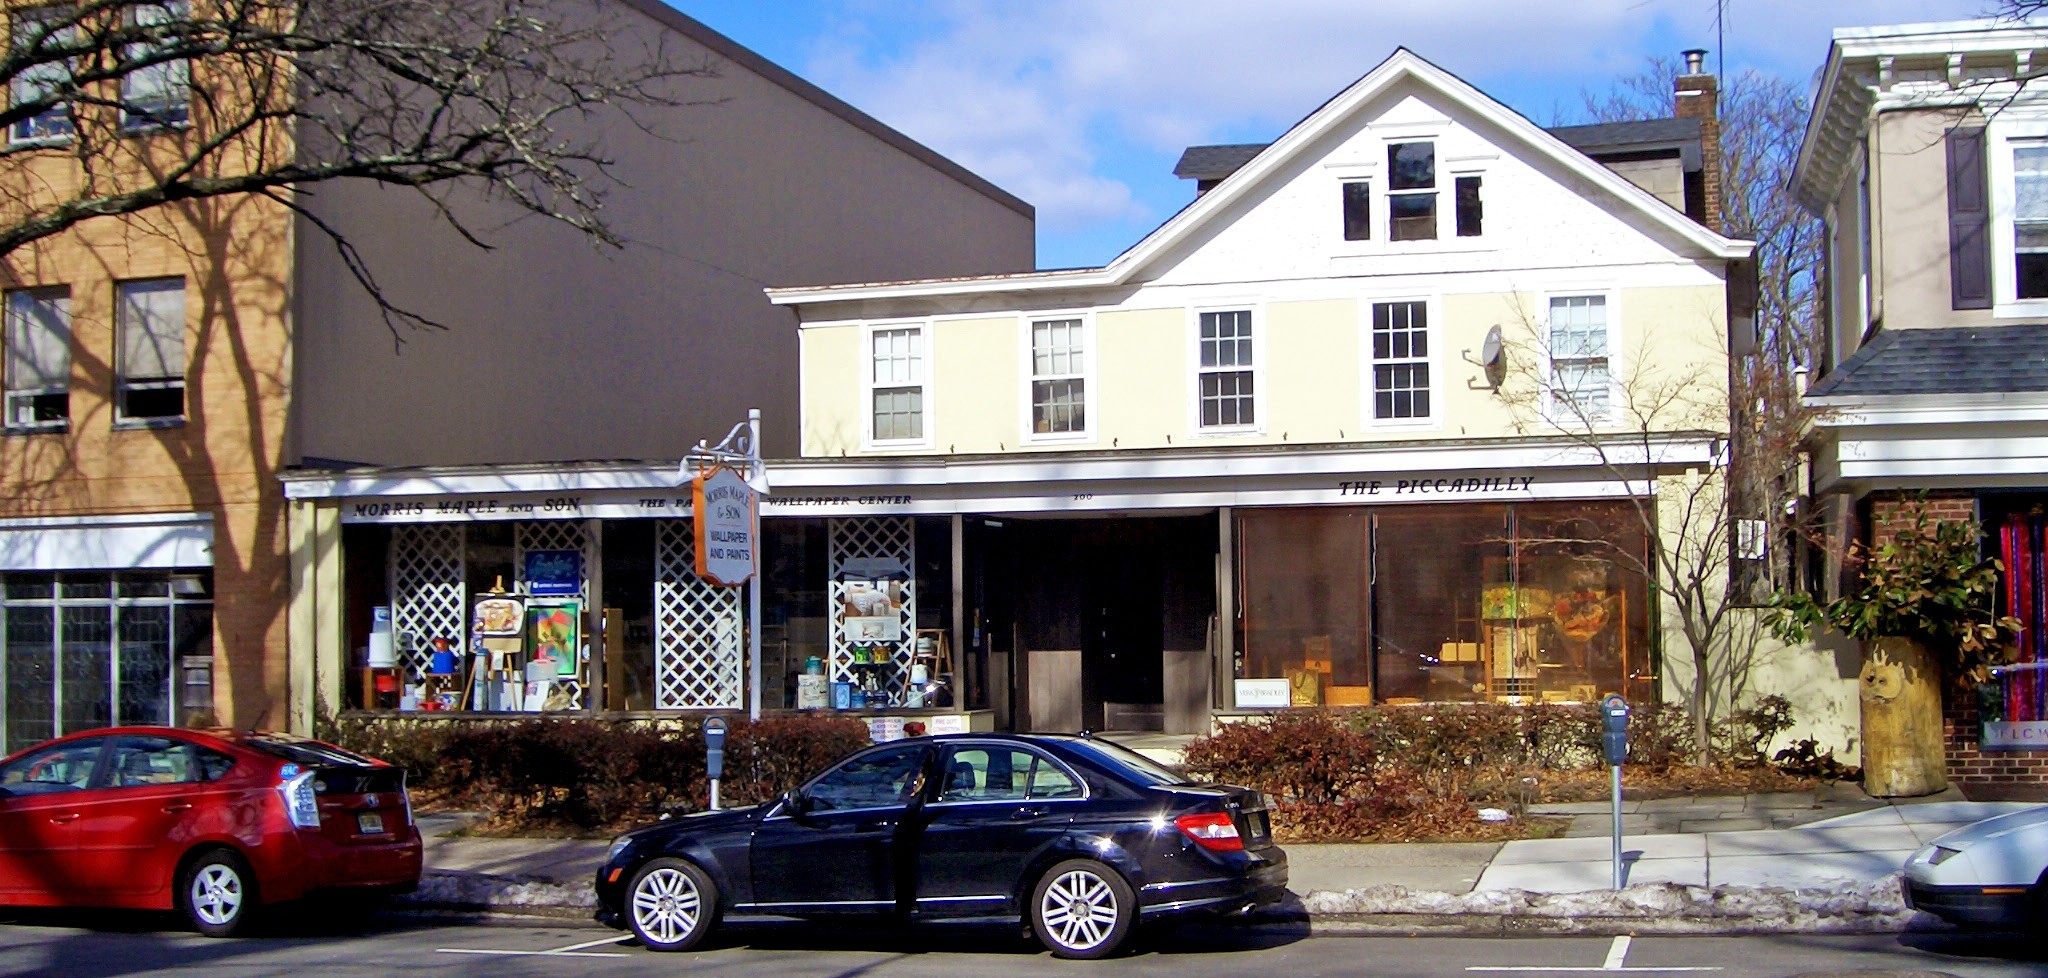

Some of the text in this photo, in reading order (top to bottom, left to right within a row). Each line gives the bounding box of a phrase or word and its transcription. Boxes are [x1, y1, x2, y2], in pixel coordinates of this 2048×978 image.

[1339, 476, 1535, 496] THE PICCADILLY
[639, 499, 667, 508] THE
[767, 497, 850, 506] WALLPAPER
[858, 495, 913, 505] CENTER
[706, 485, 750, 508] MORRIS MAPLE
[353, 497, 580, 517] MORRIS MAPLE AND SON
[725, 504, 741, 519] SON
[710, 530, 748, 543] WALLPAPER
[710, 548, 750, 561] AND PAINTS
